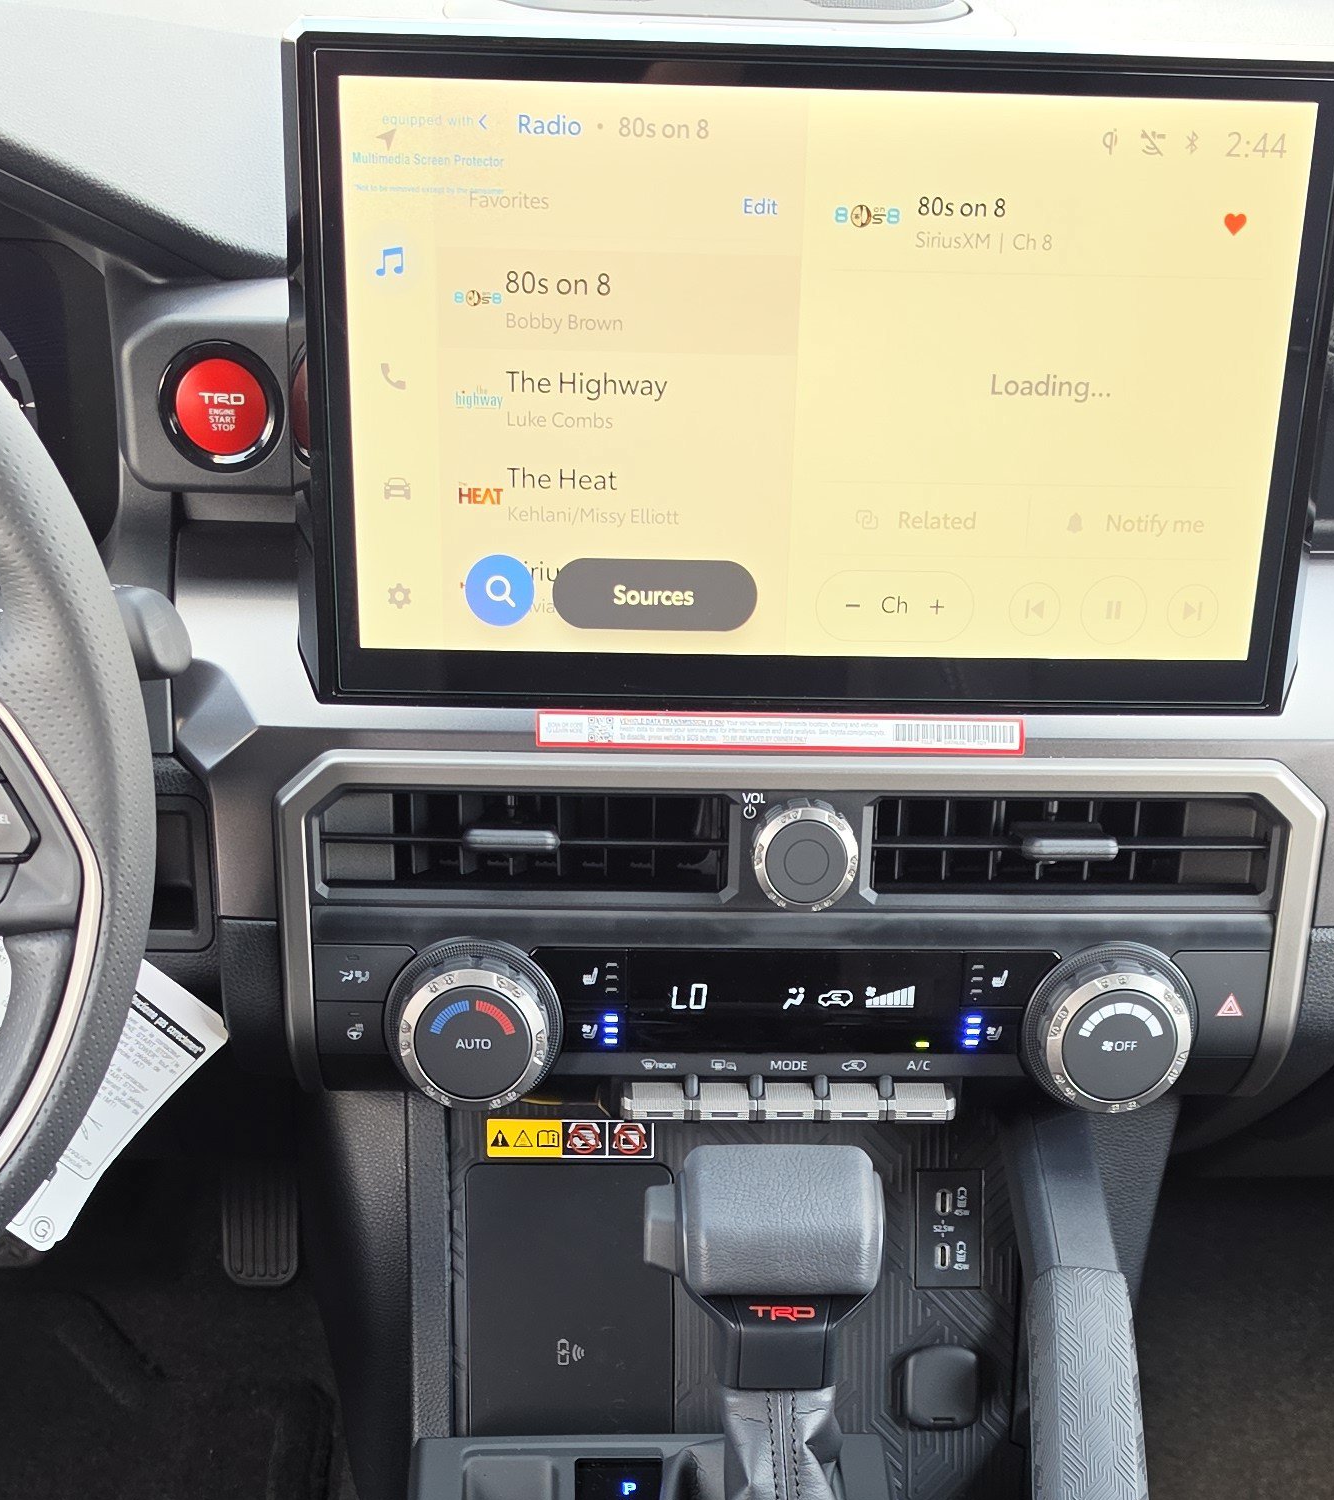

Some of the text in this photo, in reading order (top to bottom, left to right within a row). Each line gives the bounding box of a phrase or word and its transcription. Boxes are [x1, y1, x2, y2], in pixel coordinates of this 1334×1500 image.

[382, 112, 474, 127] equipped with
[518, 114, 582, 137] Radio
[618, 116, 709, 139] 80s on 8
[1224, 132, 1287, 159] 2:44
[352, 152, 504, 168] Multimedia Screen Protector
[468, 192, 549, 210] Favorites
[743, 198, 778, 216] Edit
[918, 197, 1006, 218] 80s on 8
[915, 232, 1053, 251] SiriusXM Ch 8
[506, 270, 611, 296] 80s on 8
[506, 313, 623, 334] Bobby Brown
[506, 370, 668, 401] The Highway
[990, 374, 1111, 403] Loading...
[199, 392, 245, 405] TRD
[455, 391, 503, 409] highway
[507, 411, 613, 429] Luke Combs
[507, 467, 618, 491] The Heat
[458, 488, 503, 504] HEAT
[507, 507, 680, 527] Kehlani/Missy Elliott
[898, 511, 976, 531] Related
[1106, 514, 1205, 537] Notify me
[613, 584, 694, 607] Sources
[881, 595, 908, 615] Ch
[742, 793, 766, 804] VOL
[672, 983, 708, 1010] LO
[154, 1017, 168, 1028] pas
[455, 1038, 491, 1050] AUTO
[1115, 1041, 1137, 1051] OFF
[655, 1062, 677, 1070] FRONT
[770, 1060, 808, 1071] MODE
[907, 1060, 930, 1071] A/C
[749, 1305, 815, 1321] TRD
[622, 1482, 636, 1494] P
